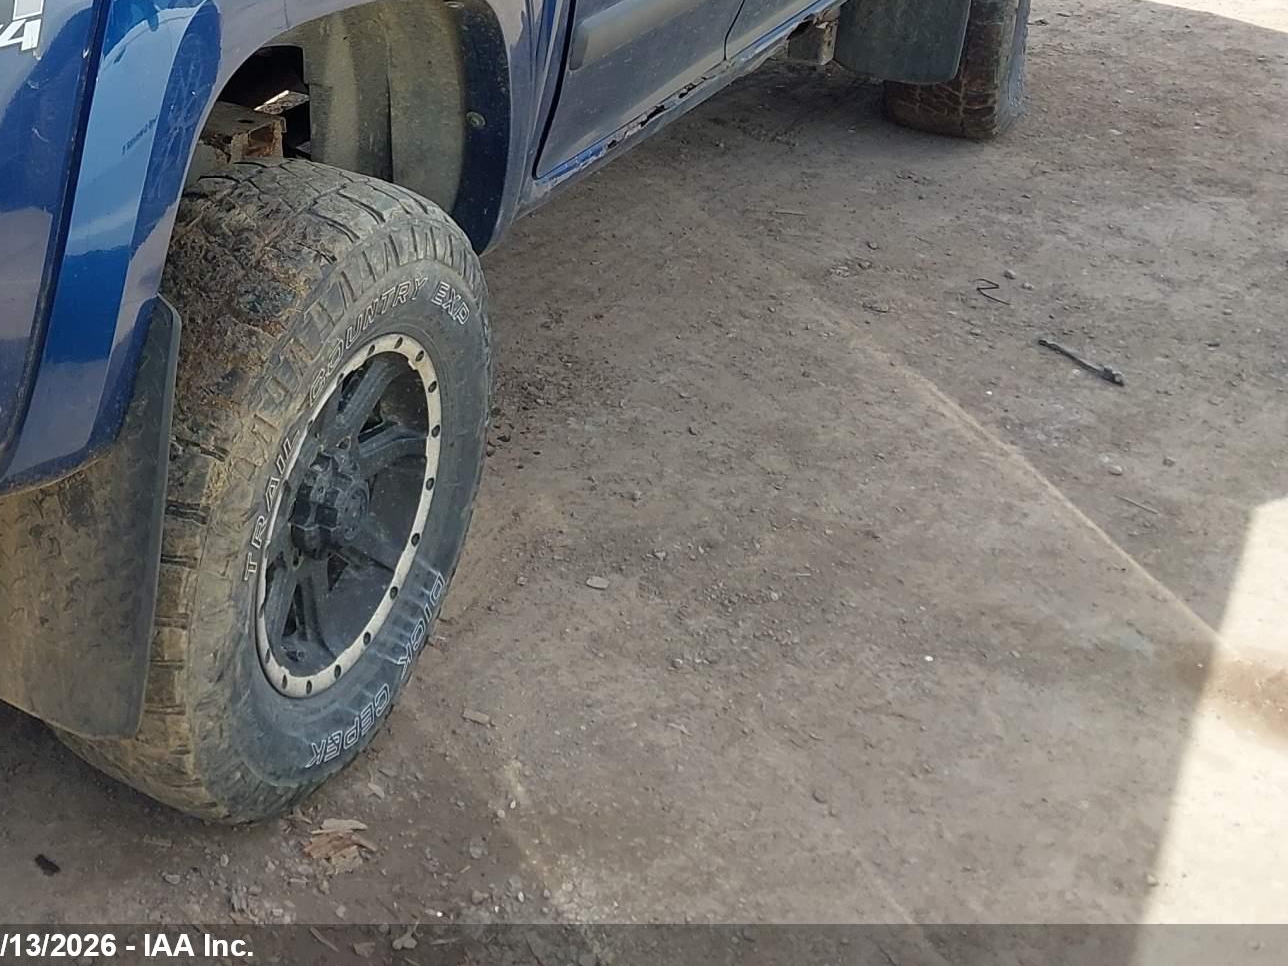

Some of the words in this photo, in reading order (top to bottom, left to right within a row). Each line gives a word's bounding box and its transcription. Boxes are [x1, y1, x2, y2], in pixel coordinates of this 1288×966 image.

[244, 430, 300, 581] TRAIL
[310, 275, 429, 408] COUNTRY
[431, 280, 471, 326] EXP
[397, 572, 446, 682] DICK
[304, 682, 391, 769] CEPEK
